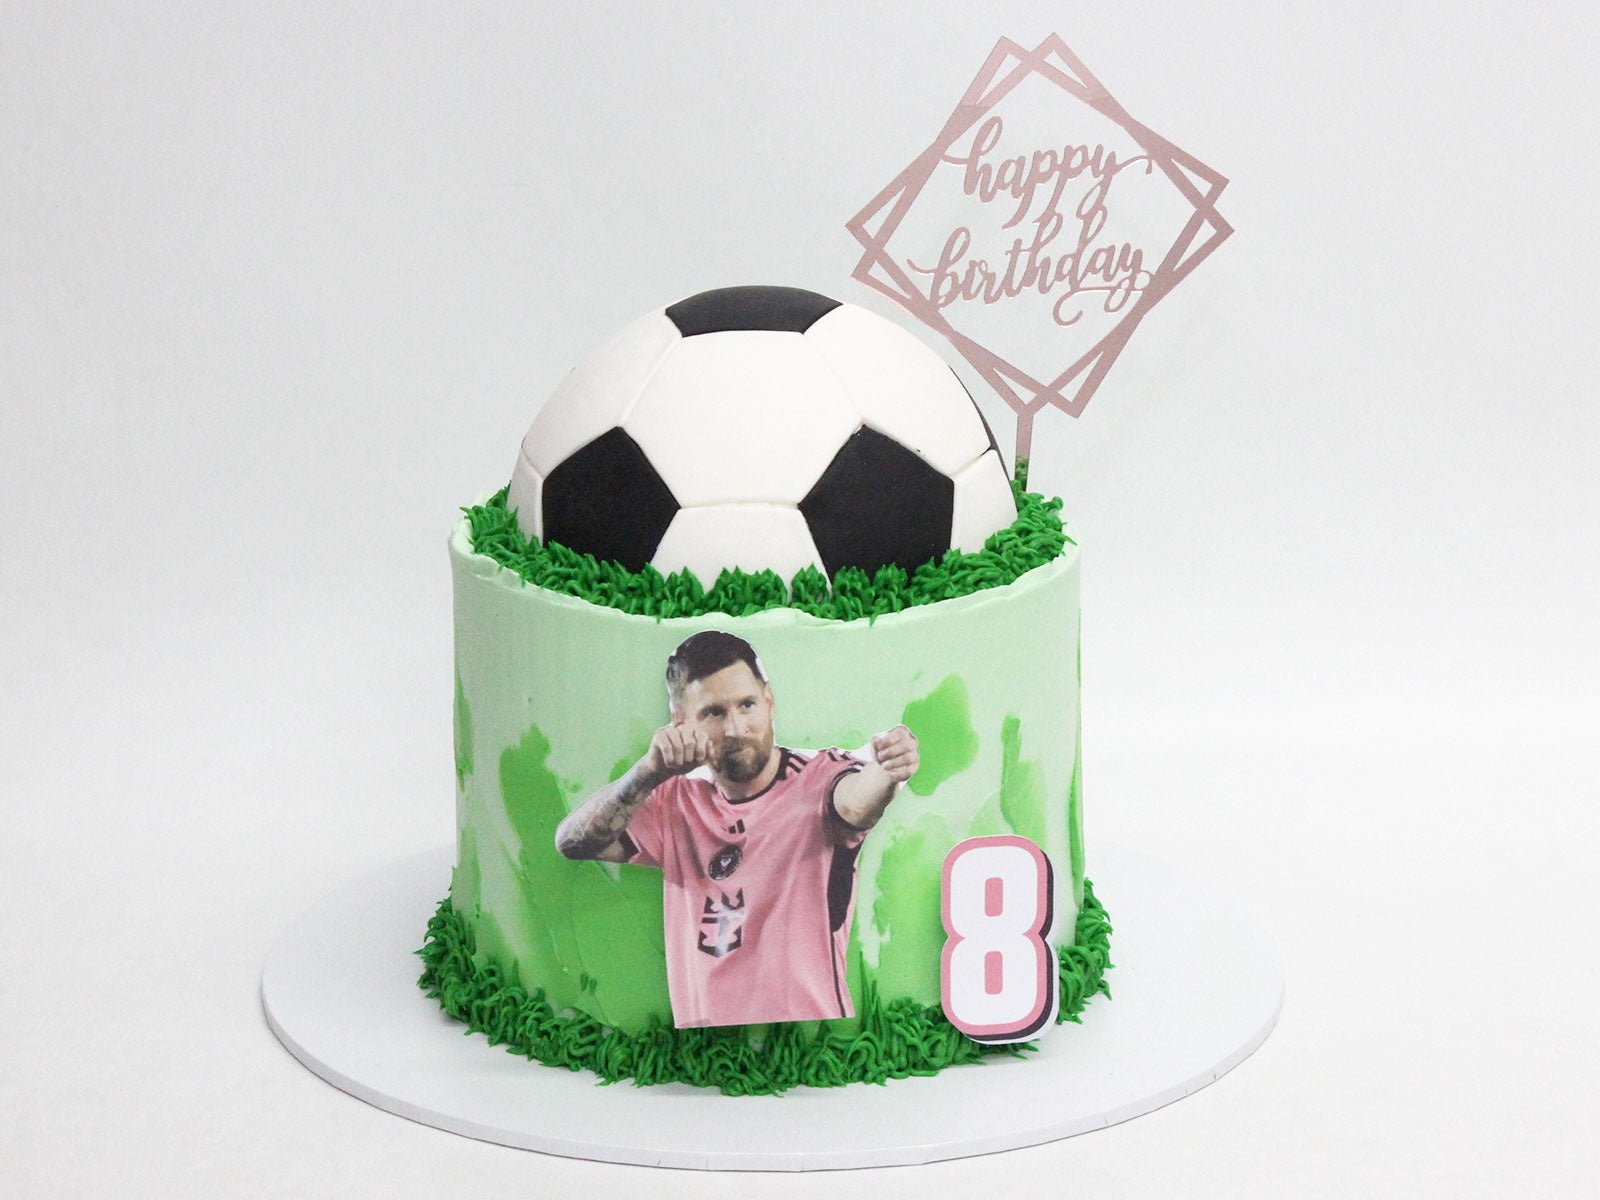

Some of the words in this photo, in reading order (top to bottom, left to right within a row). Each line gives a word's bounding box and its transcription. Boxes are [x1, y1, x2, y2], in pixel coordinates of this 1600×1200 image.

[941, 115, 1152, 230] happy
[907, 204, 1152, 326] birthday
[940, 835, 1054, 1041] 8
